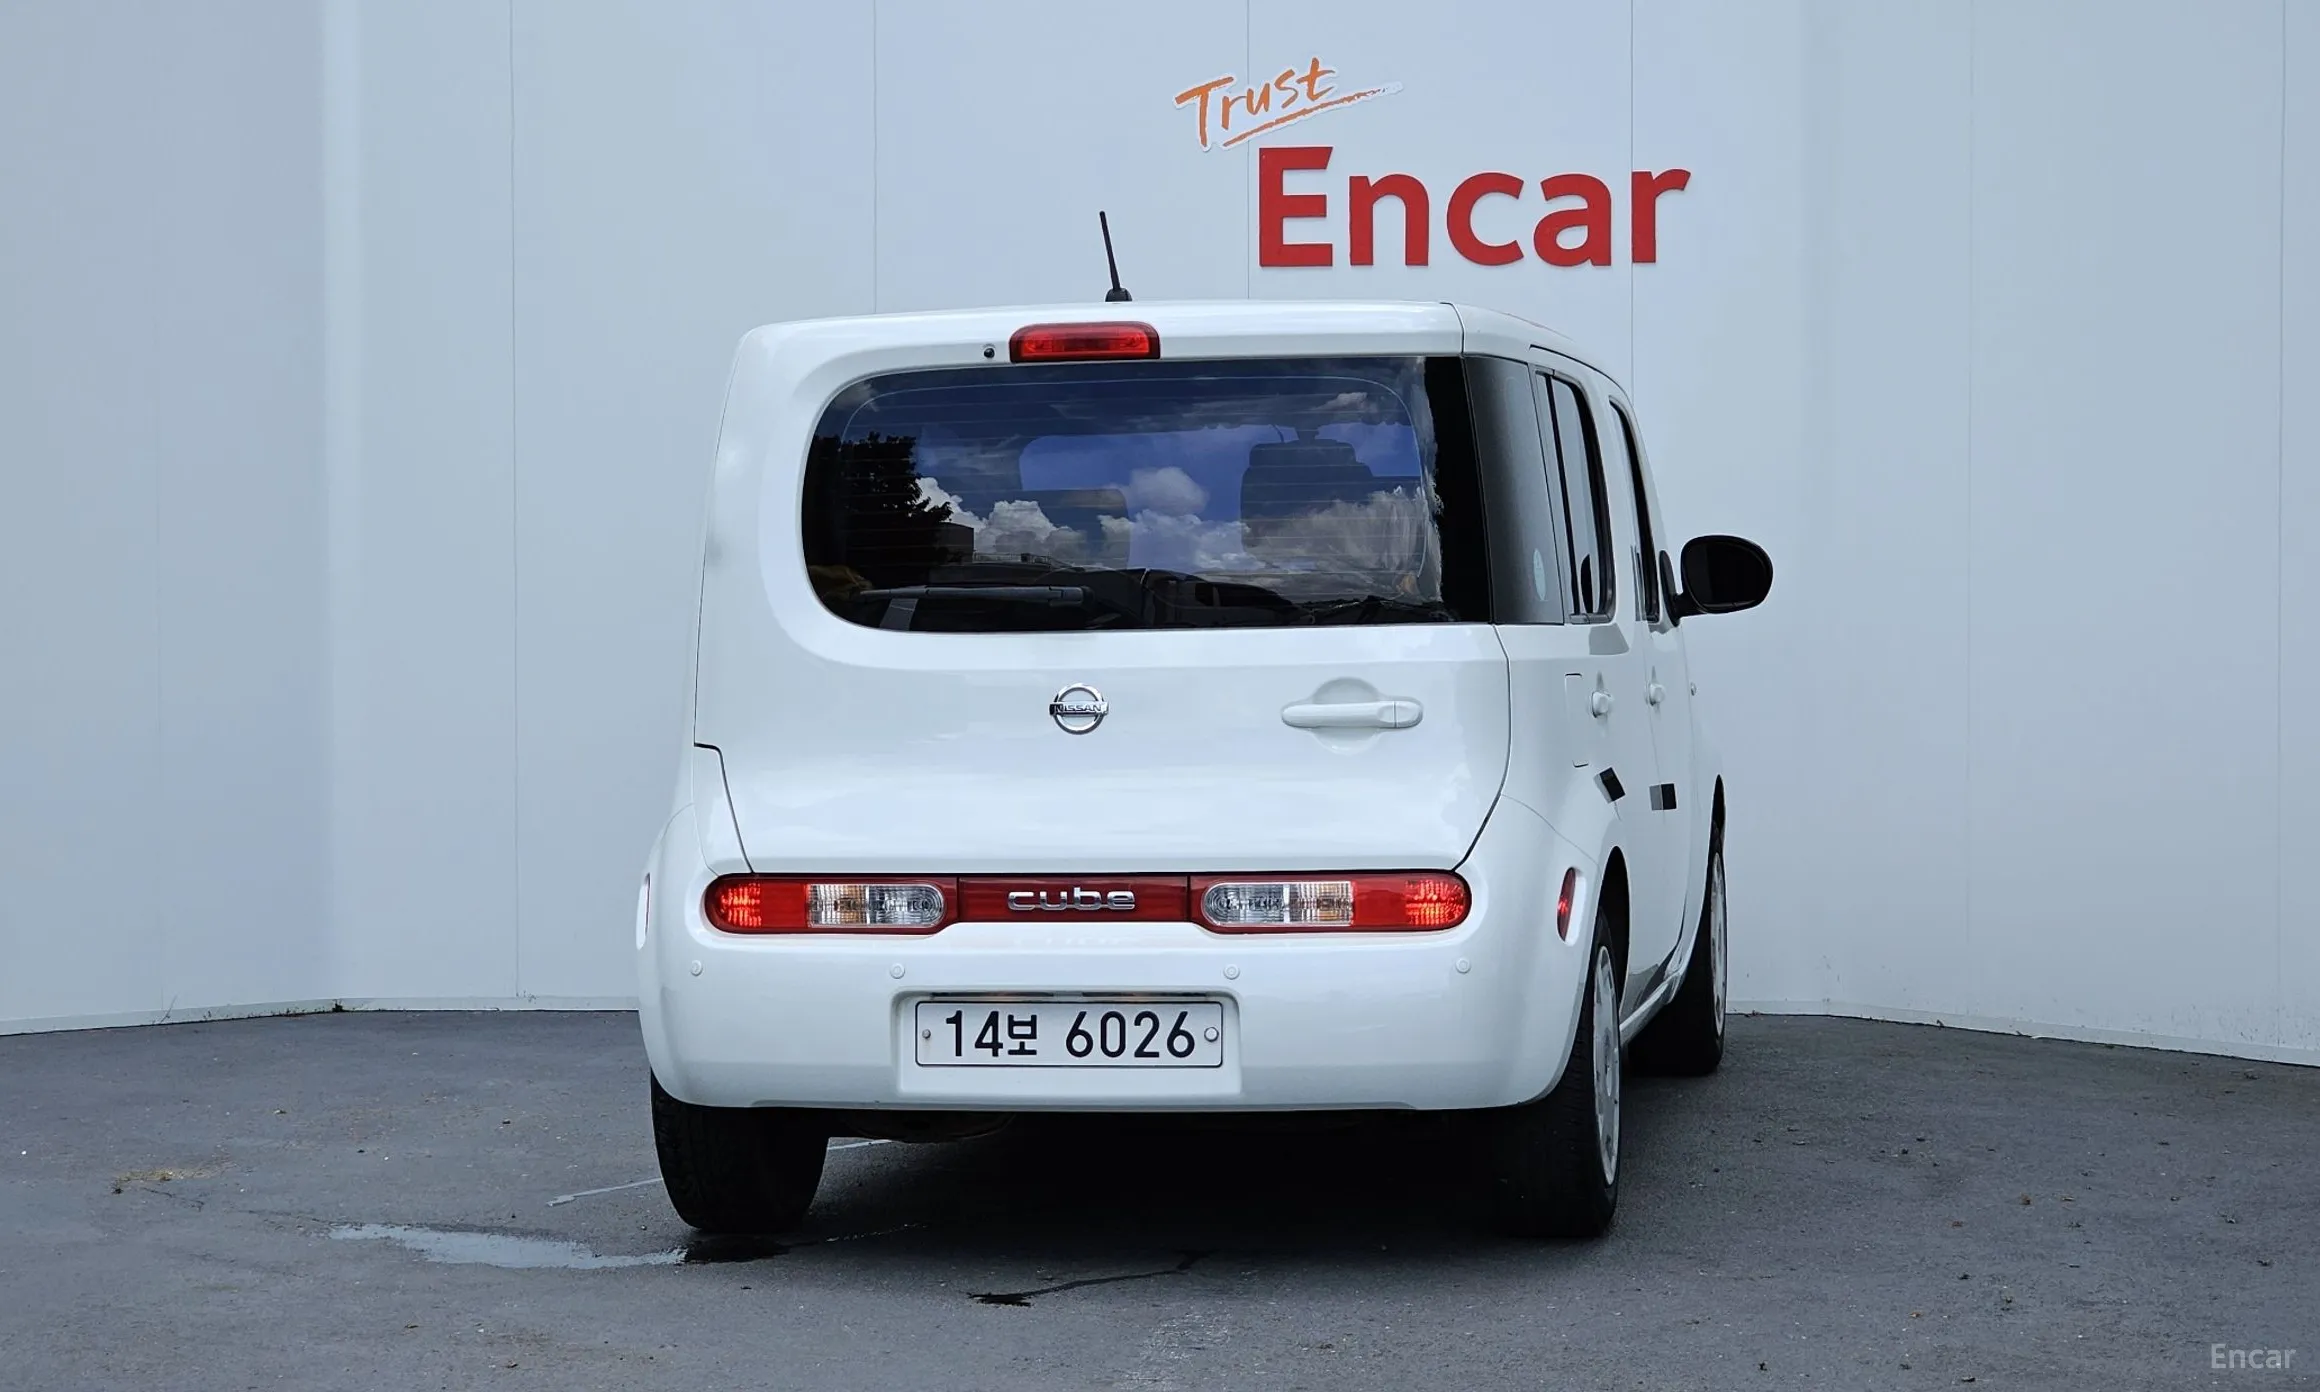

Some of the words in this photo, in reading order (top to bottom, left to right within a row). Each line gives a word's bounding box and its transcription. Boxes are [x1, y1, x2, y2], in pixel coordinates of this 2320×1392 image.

[1175, 57, 1336, 147] Trust
[1259, 146, 1691, 267] Encar
[1054, 703, 1102, 712] NISSAN
[1008, 887, 1136, 911] cube
[945, 1010, 1038, 1057] 14보
[1065, 1010, 1196, 1058] 6026
